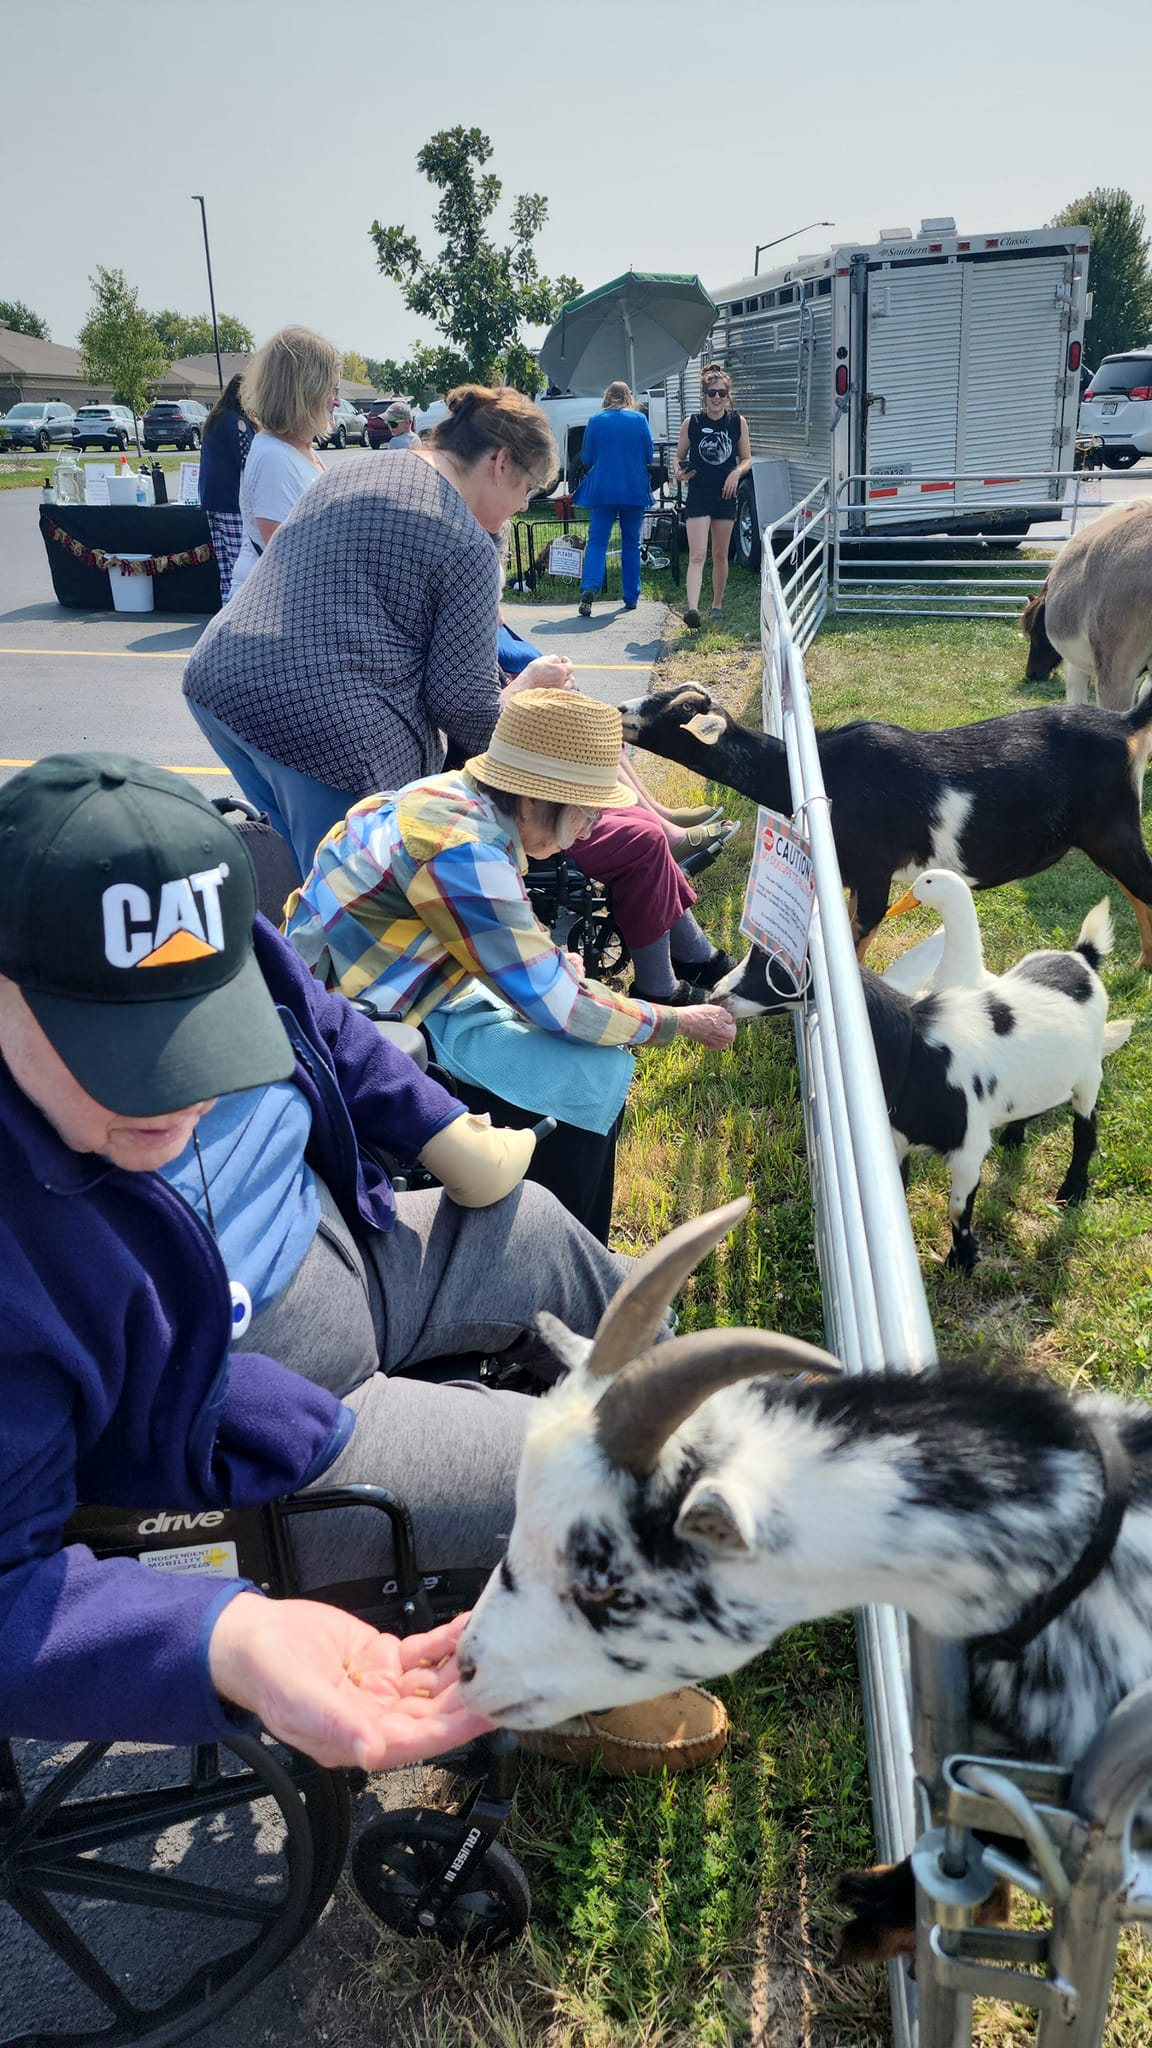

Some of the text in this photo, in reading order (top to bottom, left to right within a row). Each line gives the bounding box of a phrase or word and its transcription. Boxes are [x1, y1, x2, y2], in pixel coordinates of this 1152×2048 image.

[888, 235, 1031, 256] Southern Classic
[775, 836, 811, 880] CAUTION
[102, 866, 226, 968] CAT
[138, 1511, 225, 1535] drive
[147, 1551, 209, 1562] INDEPENDENT
[148, 1556, 202, 1568] MOBILITY
[187, 1561, 211, 1569] PLUS
[444, 1827, 482, 1882] CRUISER III
